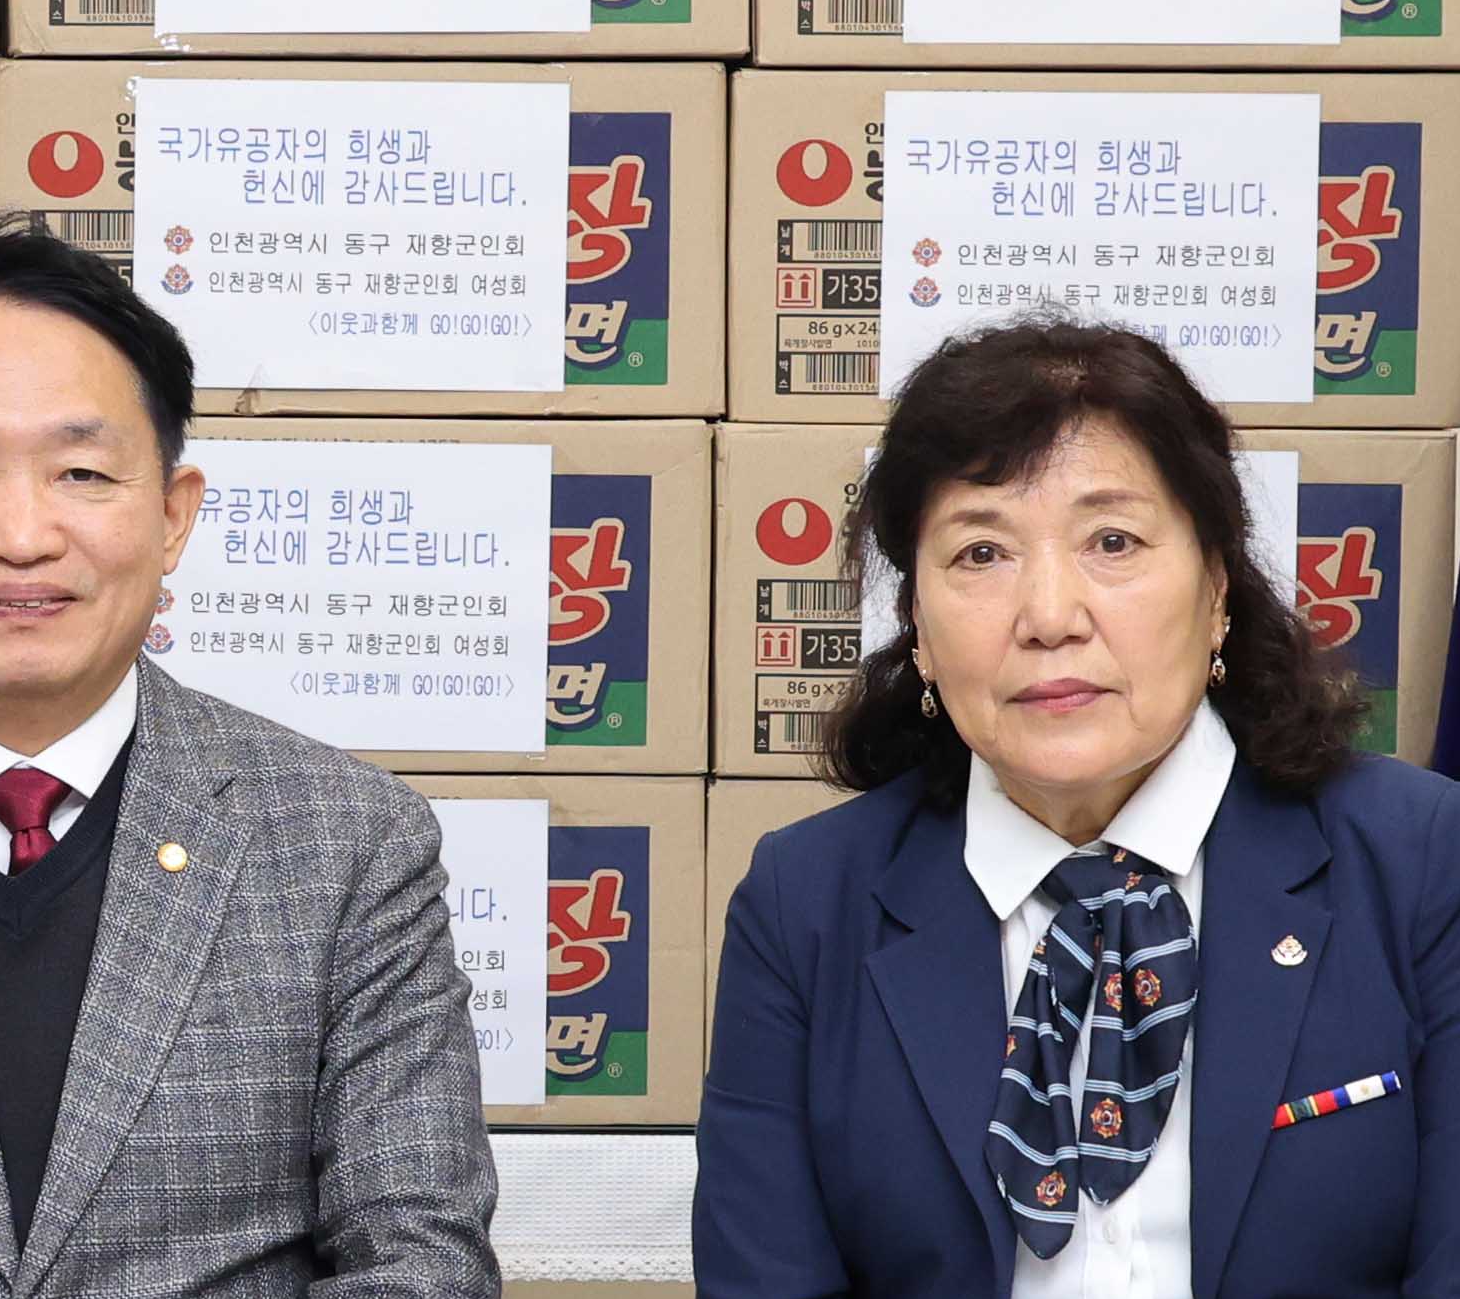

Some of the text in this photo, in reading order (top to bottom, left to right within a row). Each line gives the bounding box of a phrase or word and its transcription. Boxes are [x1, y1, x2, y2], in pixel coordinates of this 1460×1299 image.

[159, 128, 430, 164] 국가유공자의 희생과
[907, 140, 1181, 175] 국가유공자의 희생과
[244, 170, 526, 206] 헌신에 감사드립니다.
[993, 182, 1276, 216] 헌신에 감사드립니다.
[200, 489, 413, 525] 유공자의 희생과
[225, 530, 509, 566] 헌신에 감사드립니다.
[191, 593, 506, 616] 인천광역시 동구 재향군인회
